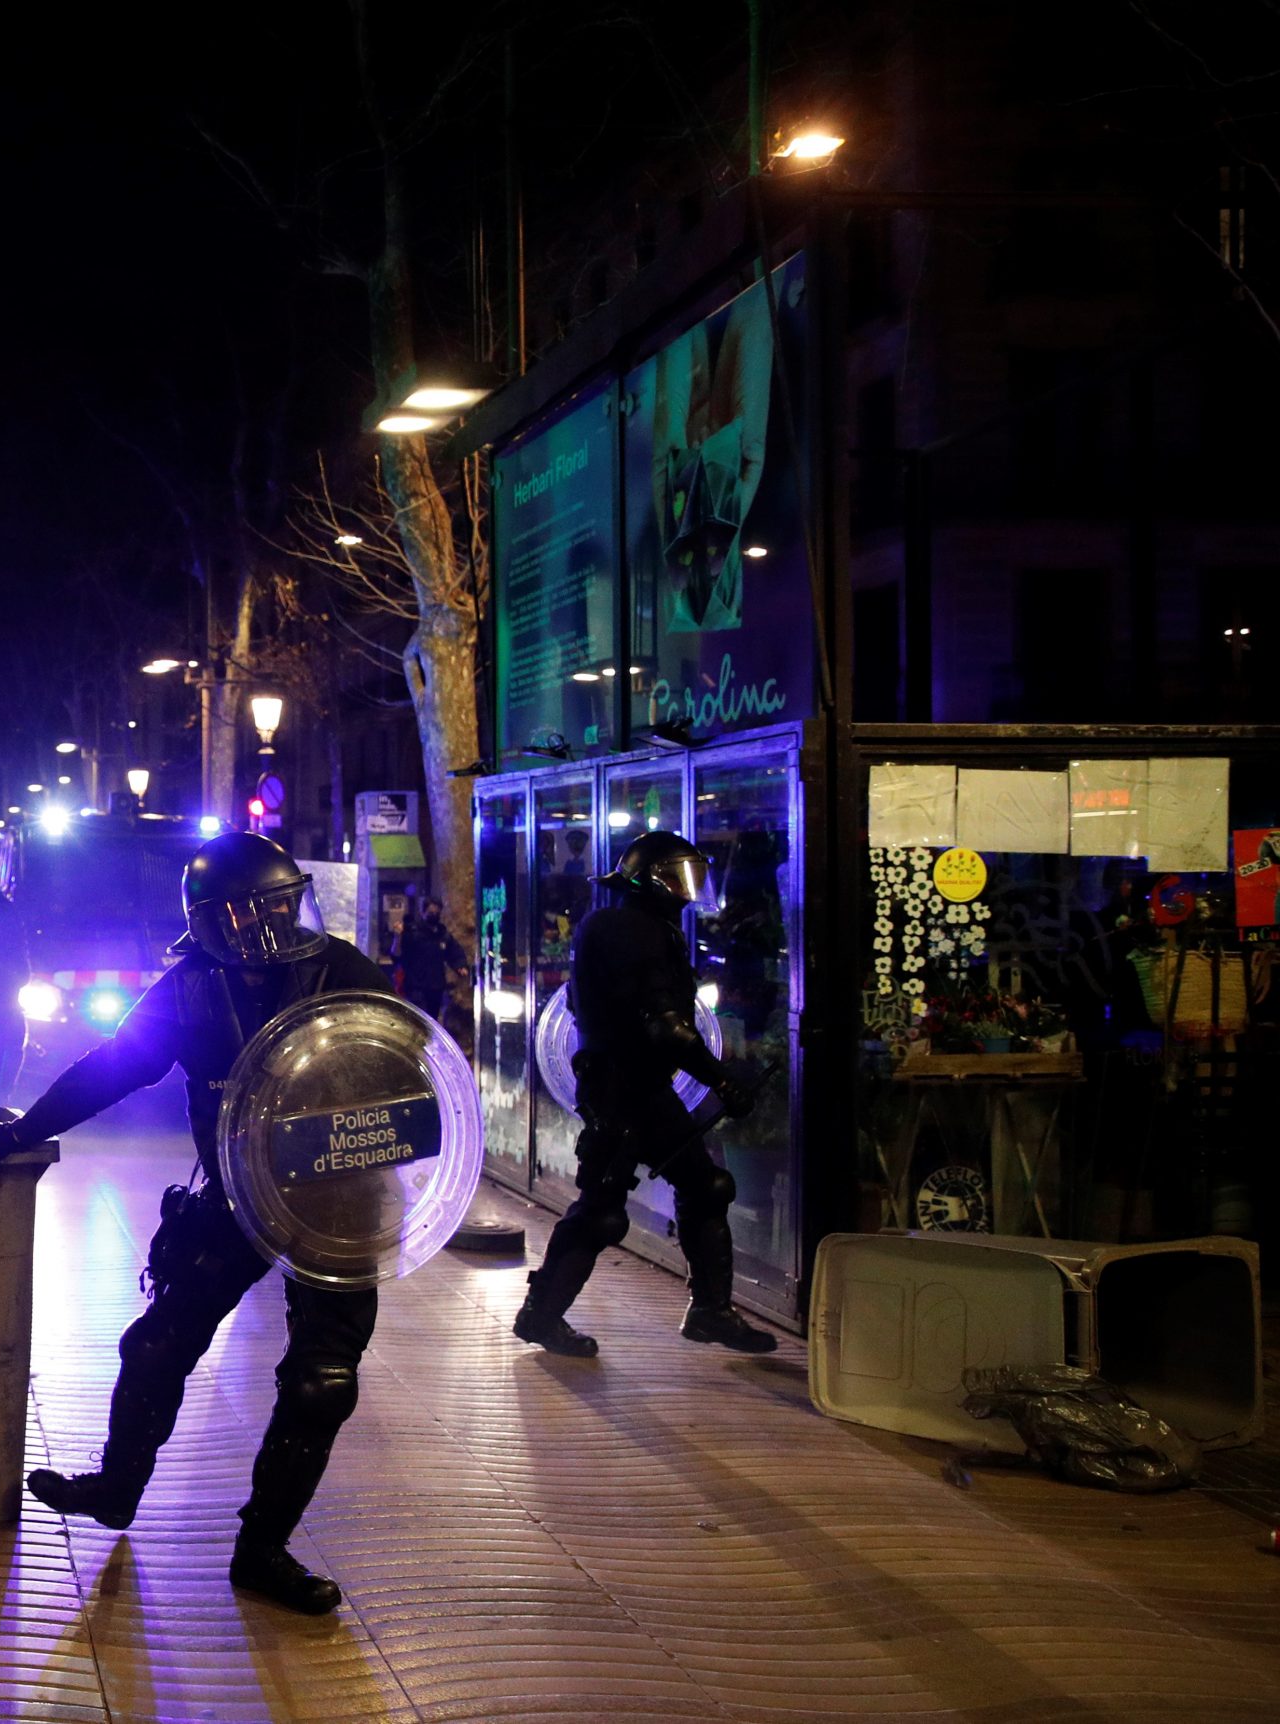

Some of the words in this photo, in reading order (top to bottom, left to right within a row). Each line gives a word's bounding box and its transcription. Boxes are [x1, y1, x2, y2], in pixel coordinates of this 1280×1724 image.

[555, 439, 589, 482] Floral
[332, 1107, 392, 1132] Policia
[329, 1127, 397, 1152] Mossos
[313, 1142, 413, 1173] d'Esquadra
